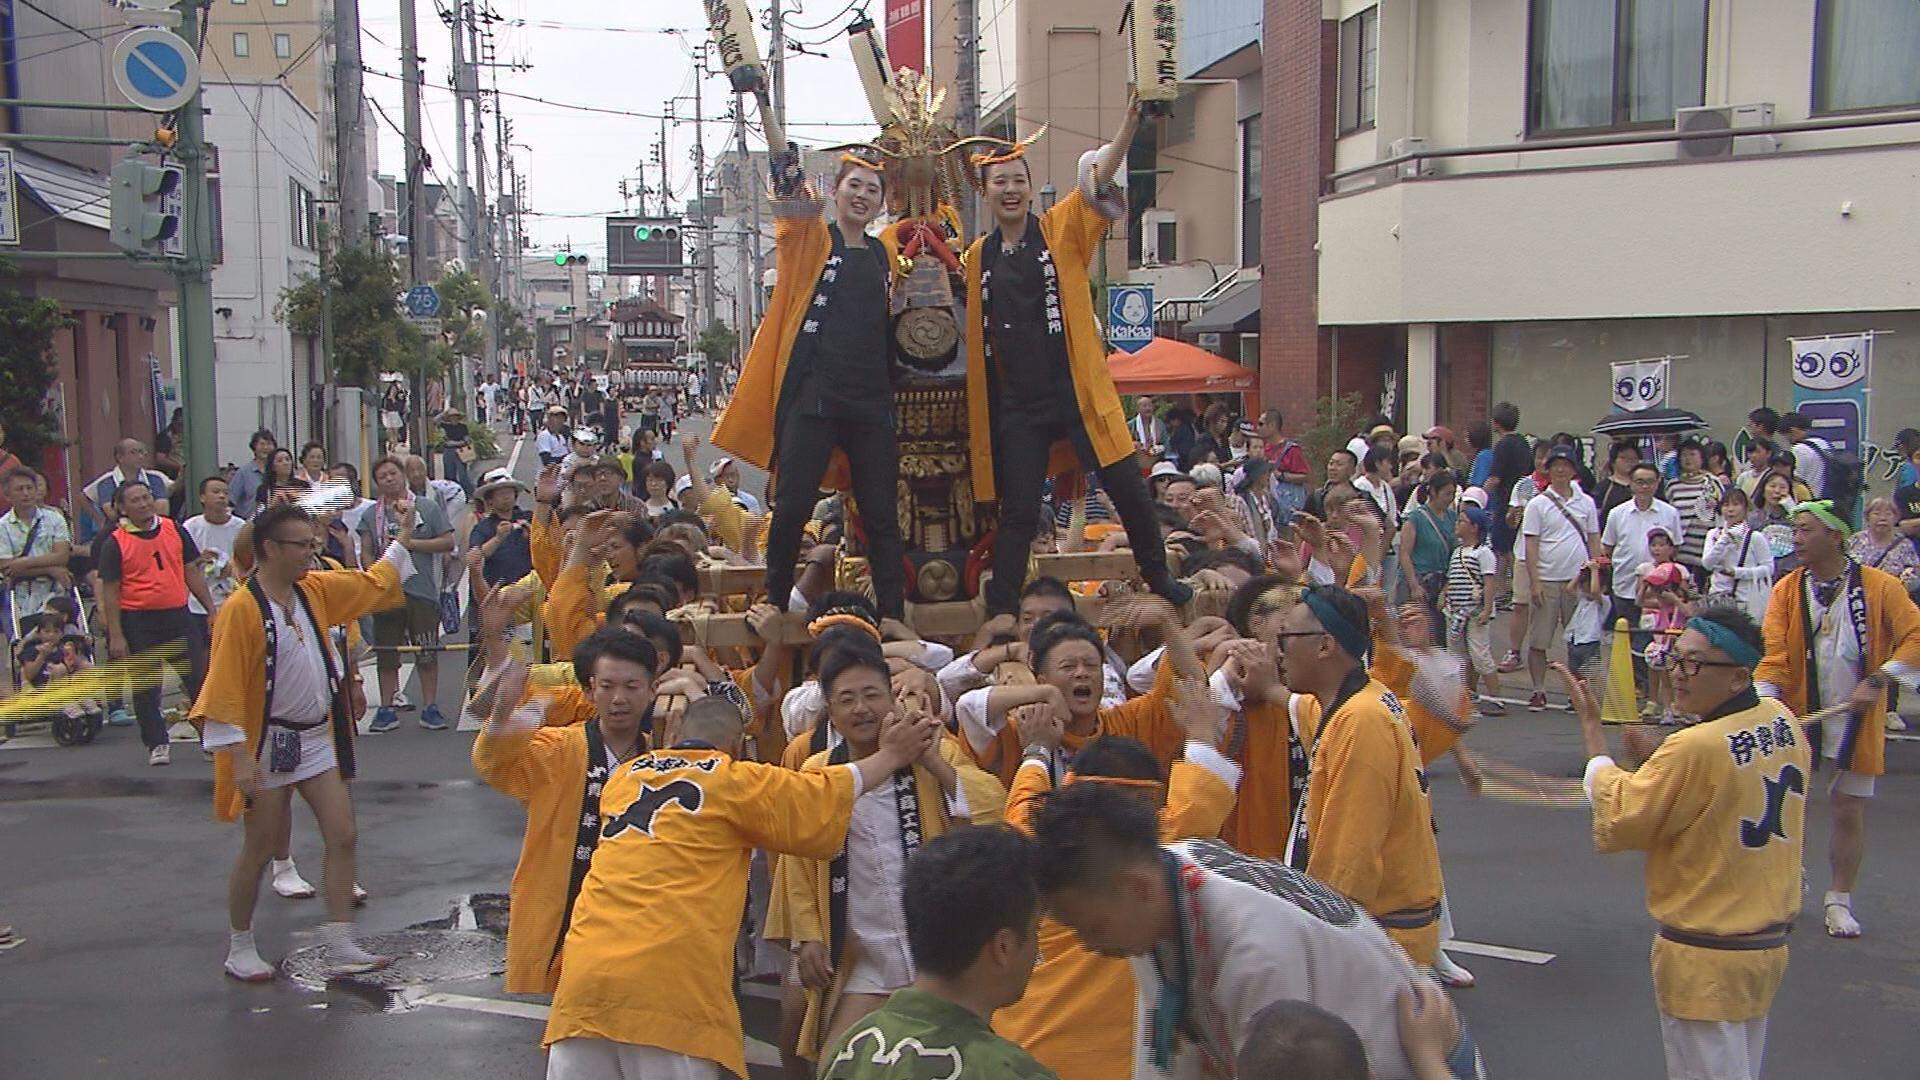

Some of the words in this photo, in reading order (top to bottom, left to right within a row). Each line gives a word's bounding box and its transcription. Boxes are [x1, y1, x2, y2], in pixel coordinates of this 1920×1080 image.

[1111, 324, 1152, 338] KaKaa
[152, 551, 164, 571] 1
[900, 795, 922, 857] 商工会
